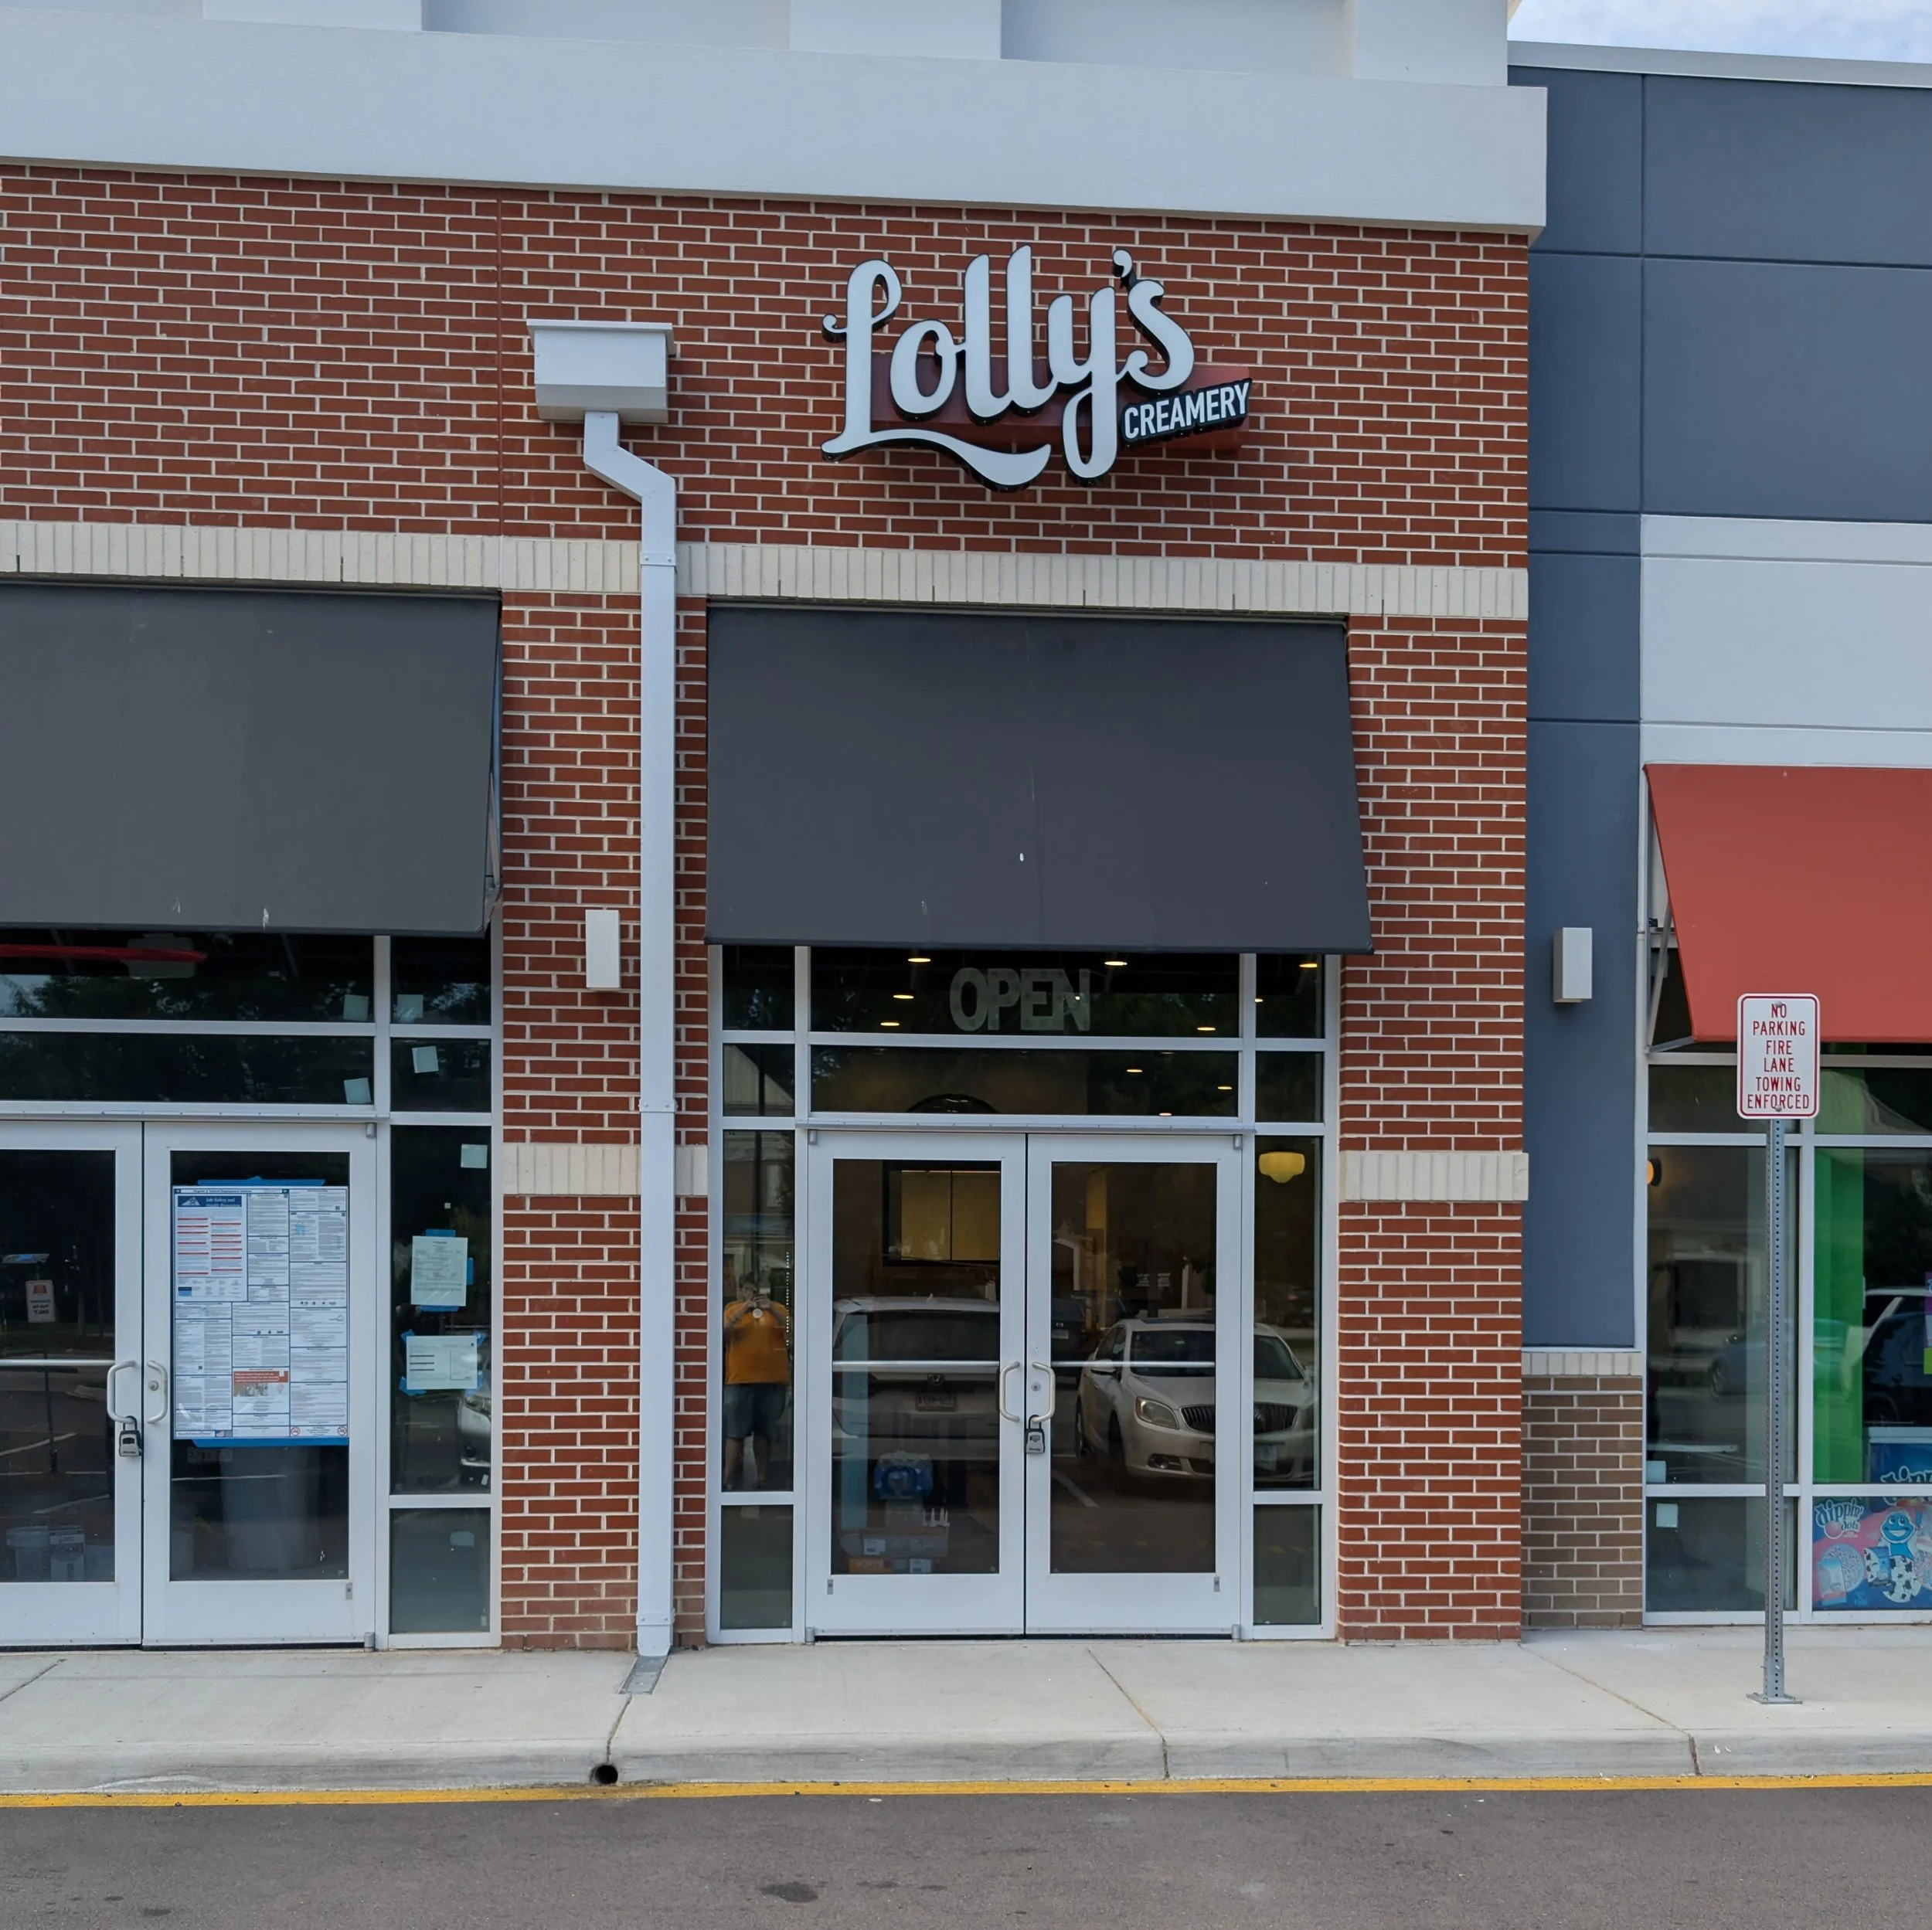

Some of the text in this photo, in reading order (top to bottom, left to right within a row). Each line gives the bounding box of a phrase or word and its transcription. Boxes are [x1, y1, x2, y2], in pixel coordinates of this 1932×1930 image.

[821, 245, 1195, 487] Lolly's
[1124, 382, 1250, 440] CREAMERY
[950, 967, 1090, 1031] OPEN
[1771, 1004, 1787, 1018] NO
[1753, 1021, 1805, 1036] PARKING
[1766, 1040, 1792, 1055] FIRE
[1764, 1058, 1794, 1072] LANE
[1756, 1076, 1801, 1092] TOWING
[1747, 1094, 1810, 1109] ENFORCED
[1841, 1520, 1859, 1531] dots
